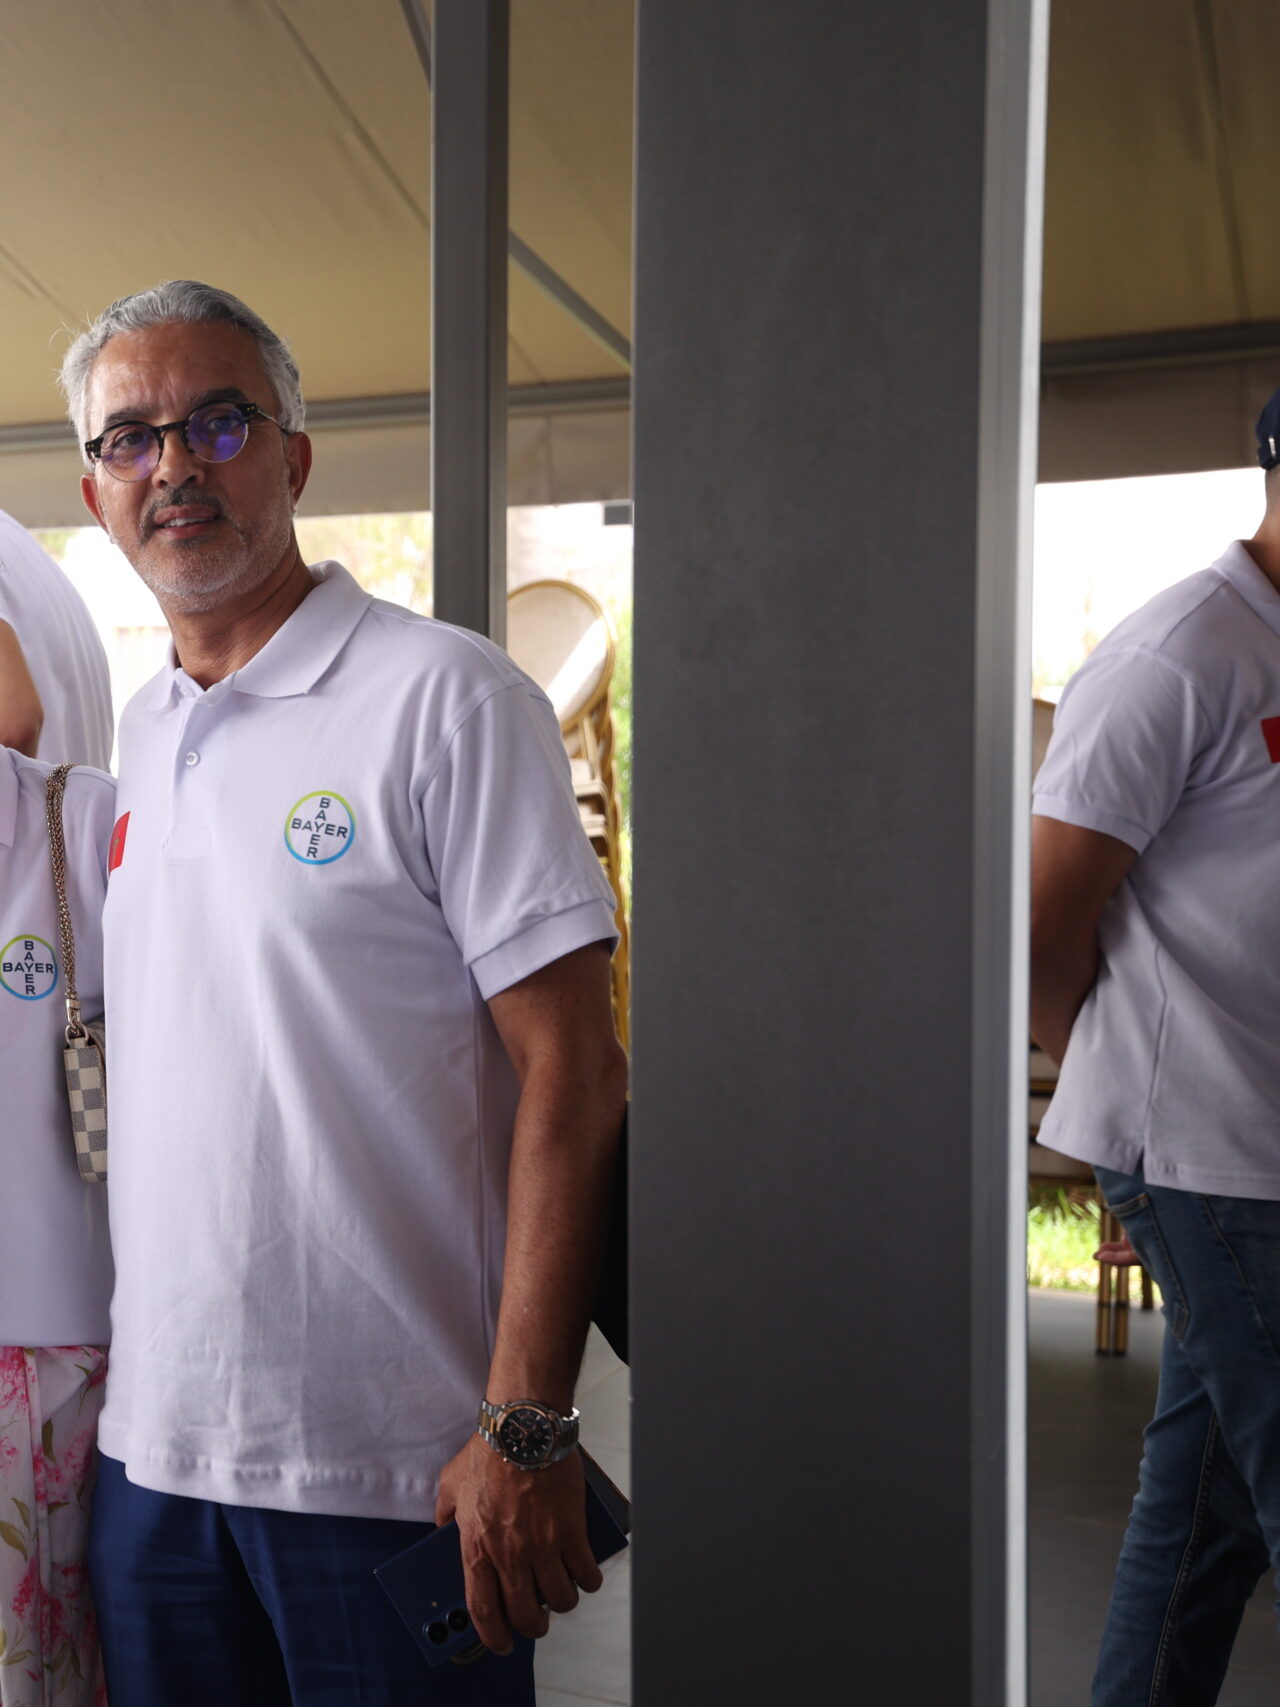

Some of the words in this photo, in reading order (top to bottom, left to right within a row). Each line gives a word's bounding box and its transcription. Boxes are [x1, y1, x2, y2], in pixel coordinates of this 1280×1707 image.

[291, 817, 348, 839] BAYER
[306, 796, 331, 858] BAYER
[2, 961, 54, 974] BAYER
[23, 940, 36, 995] BAYER
